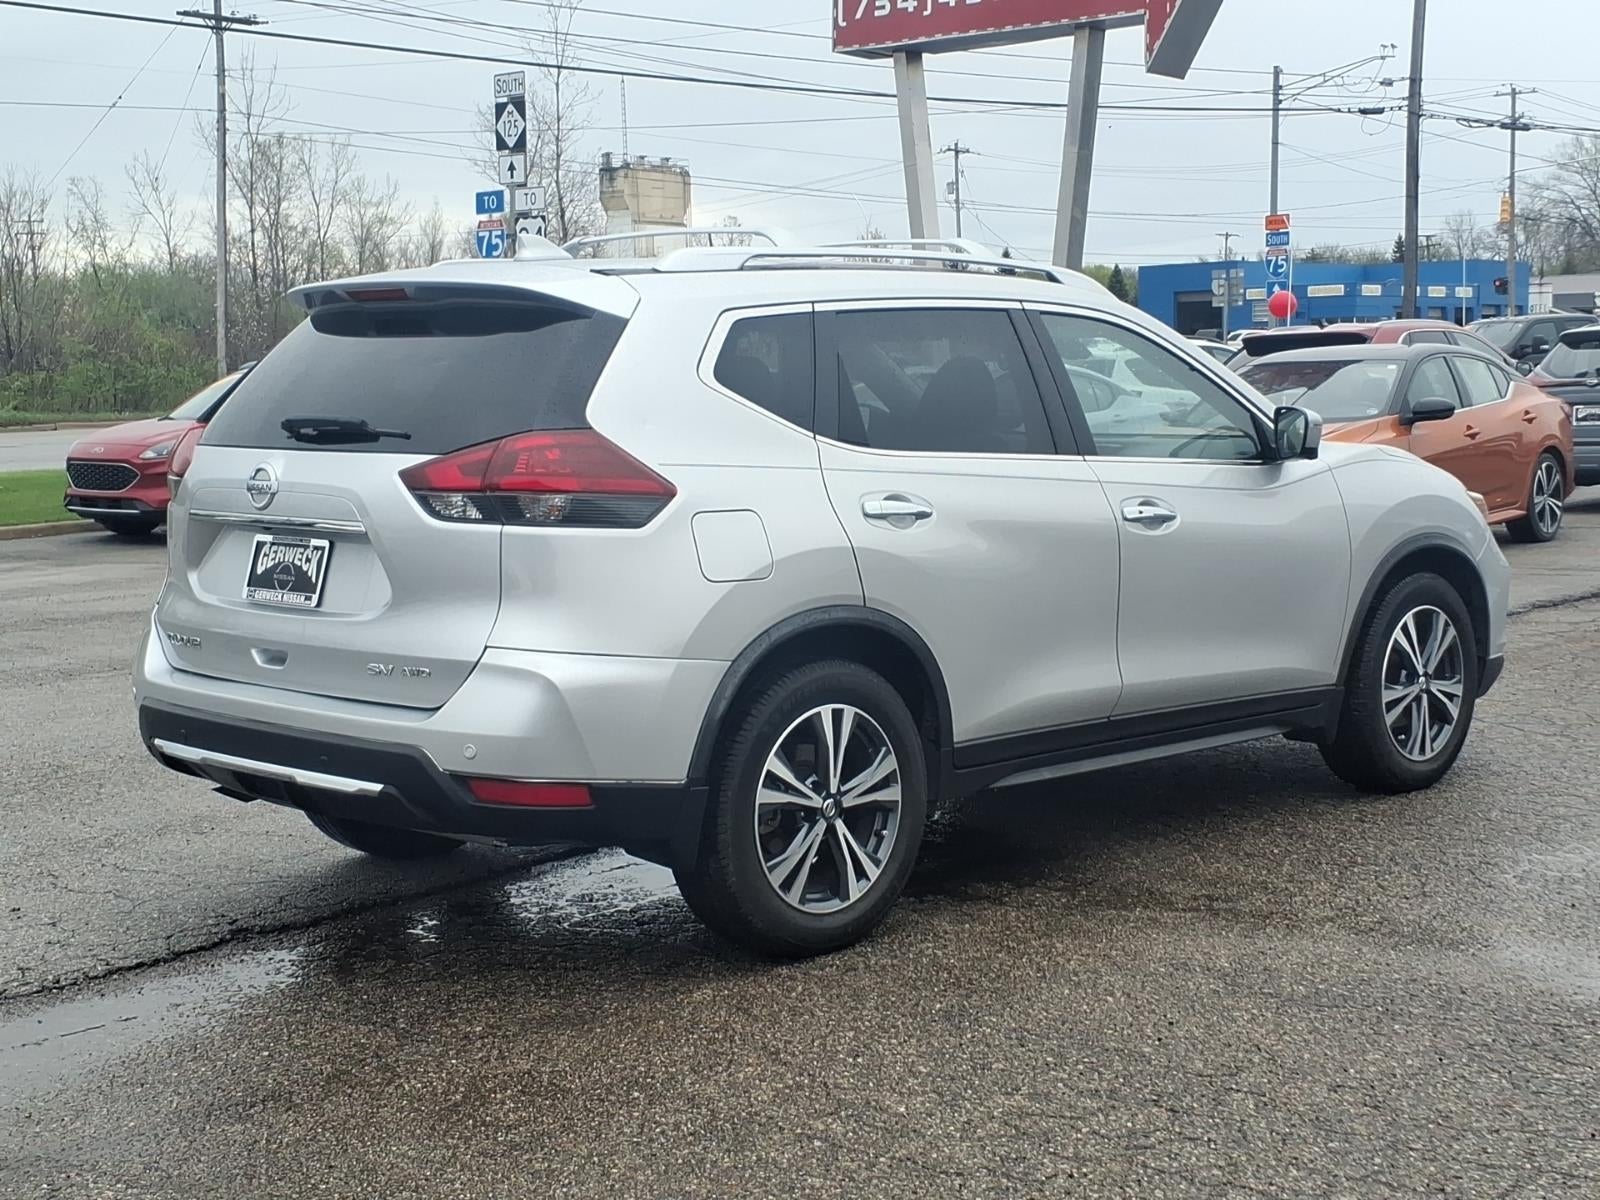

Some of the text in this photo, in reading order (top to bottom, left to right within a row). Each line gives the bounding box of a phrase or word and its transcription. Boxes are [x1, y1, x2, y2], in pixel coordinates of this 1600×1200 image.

[497, 78, 524, 94] SOUTH
[506, 109, 514, 118] M
[503, 119, 519, 138] 125
[483, 195, 497, 209] TO
[524, 192, 537, 206] TO
[478, 230, 503, 256] 75
[1267, 234, 1288, 245] SOUTH
[1266, 256, 1287, 273] 75
[257, 543, 322, 583] GERWECK
